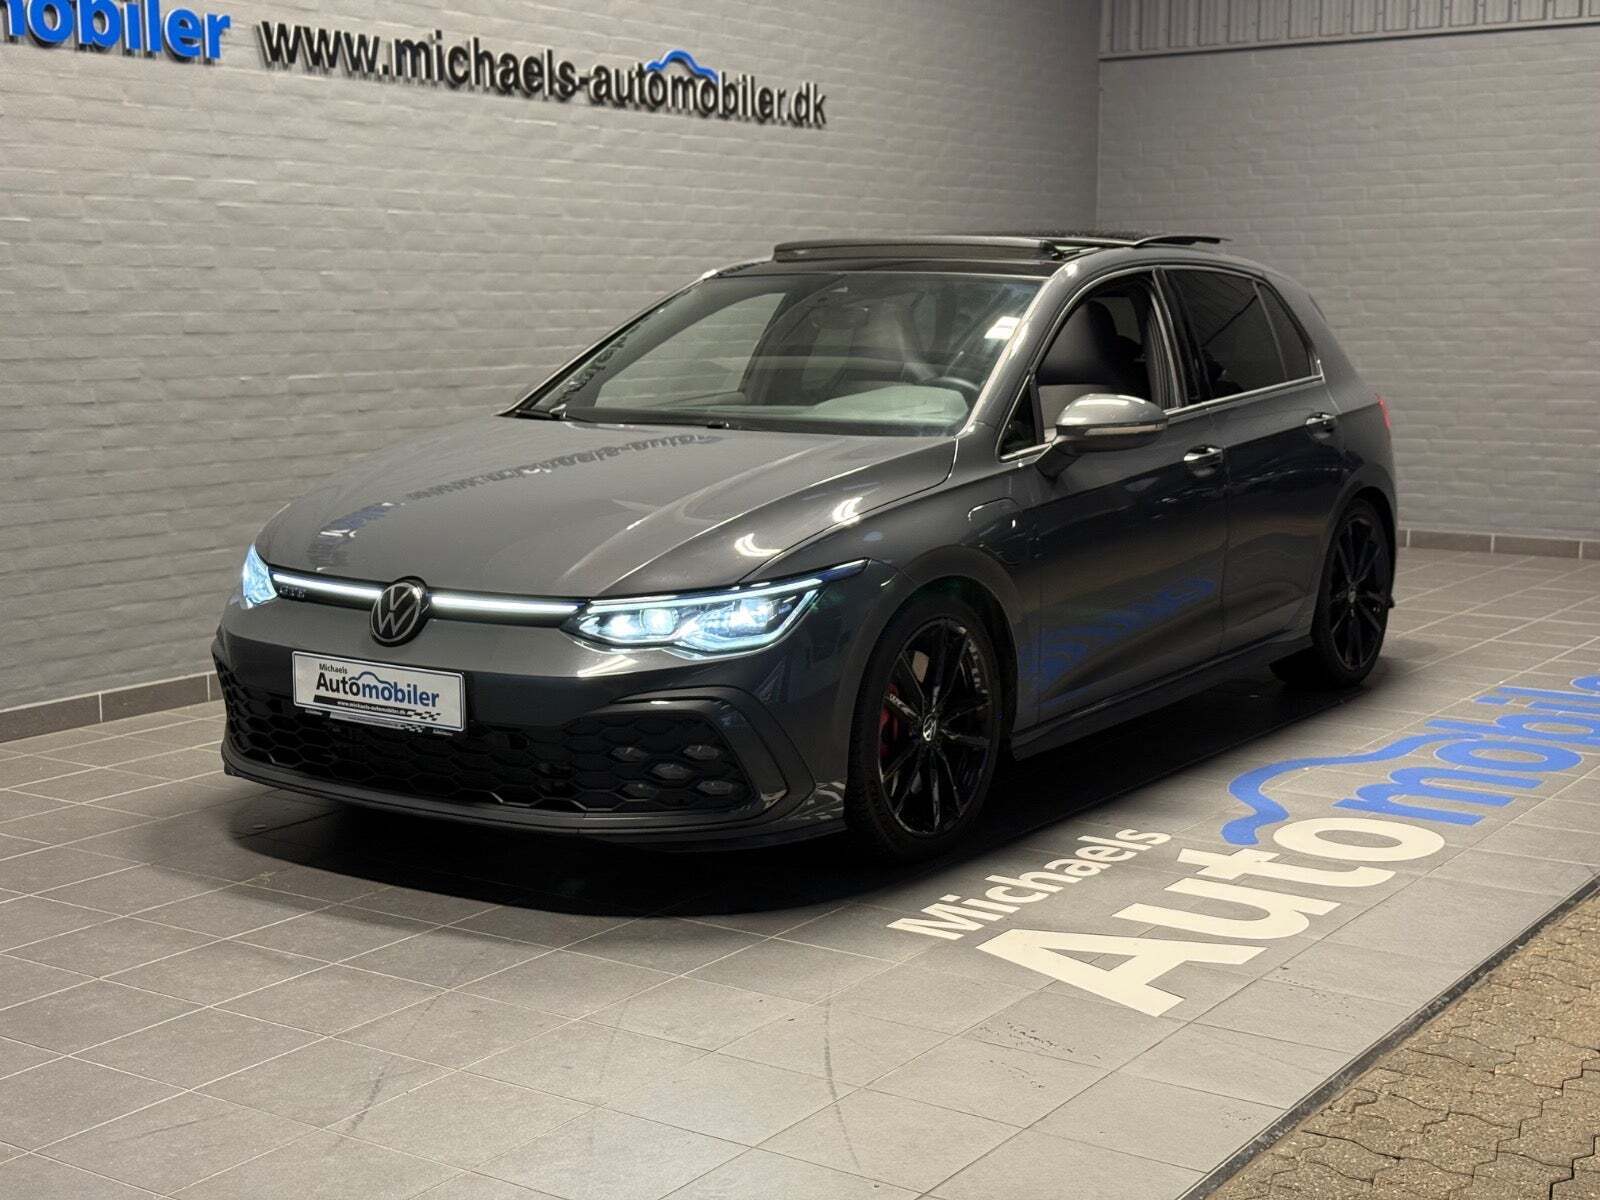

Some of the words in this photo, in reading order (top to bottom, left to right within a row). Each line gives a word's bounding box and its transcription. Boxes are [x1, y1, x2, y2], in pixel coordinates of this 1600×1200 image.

[0, 0, 231, 60] obiler
[257, 20, 827, 126] www.michaels-automobiler.dk
[316, 672, 440, 708] Automobiler
[318, 663, 348, 675] Michaels
[886, 828, 1172, 941] Michaels
[975, 674, 1600, 1018] Automobil
